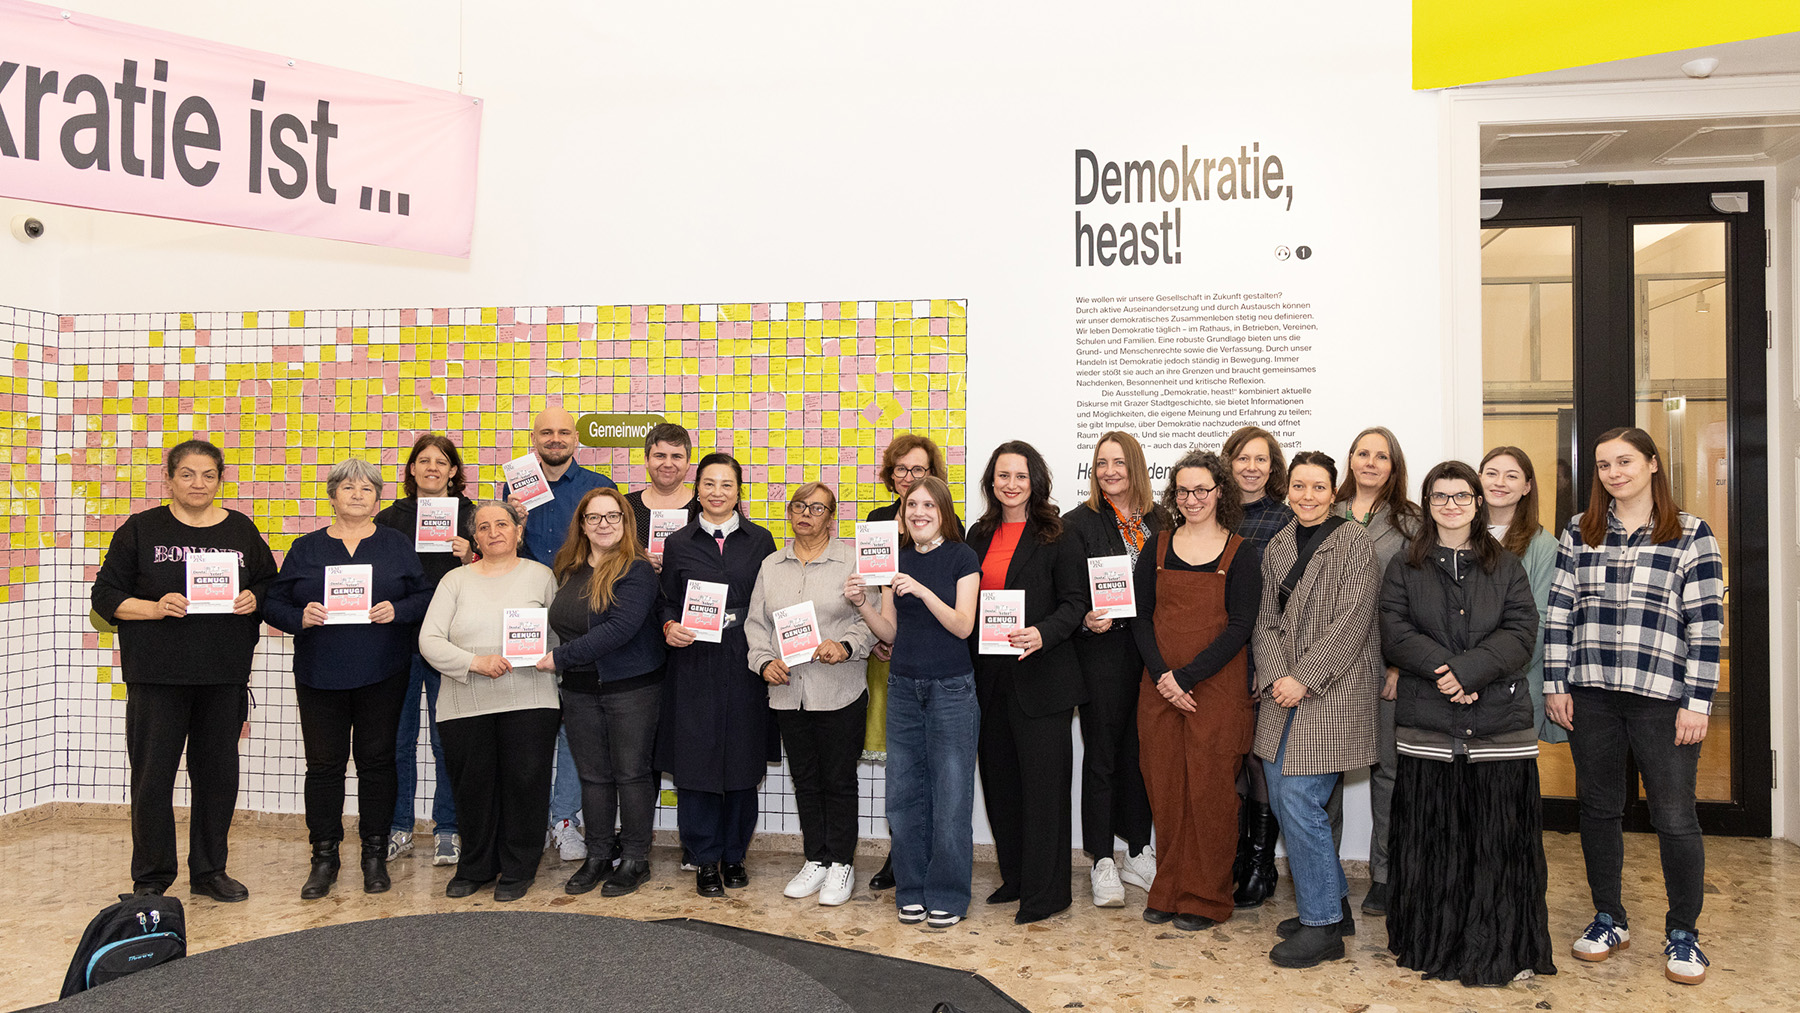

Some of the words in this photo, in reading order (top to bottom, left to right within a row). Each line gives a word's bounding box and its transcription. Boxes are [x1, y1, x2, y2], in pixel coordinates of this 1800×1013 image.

[249, 79, 338, 205] ist
[1075, 142, 1294, 211] Demokratie,
[1075, 207, 1182, 267] heast!
[1242, 291, 1282, 300] gestalten?
[1122, 304, 1198, 314] Auseinandersetzung
[1170, 314, 1233, 322] Zusammenleben
[1155, 326, 1180, 334] täglich
[1206, 335, 1246, 344] Grundlage
[1119, 346, 1181, 354] Menschenrechte
[1219, 345, 1263, 354] Verfassung.
[1191, 357, 1219, 365] ständig
[1230, 356, 1272, 364] Bewegung.
[1262, 366, 1316, 375] gemeinsames
[1115, 389, 1158, 398] Ausstellung
[1150, 398, 1213, 407] Stadtgeschichte,
[1250, 397, 1303, 405] Informationen
[1092, 410, 1145, 419] Möglichkeiten,
[1188, 409, 1220, 418] Meinung
[1238, 408, 1276, 417] Erfahrung
[1088, 421, 1103, 429] gibt
[1202, 419, 1260, 429] nachzudenken,
[514, 476, 538, 489] GENUG!
[690, 605, 717, 614] GENUG!
[784, 626, 811, 638] GENUG!
